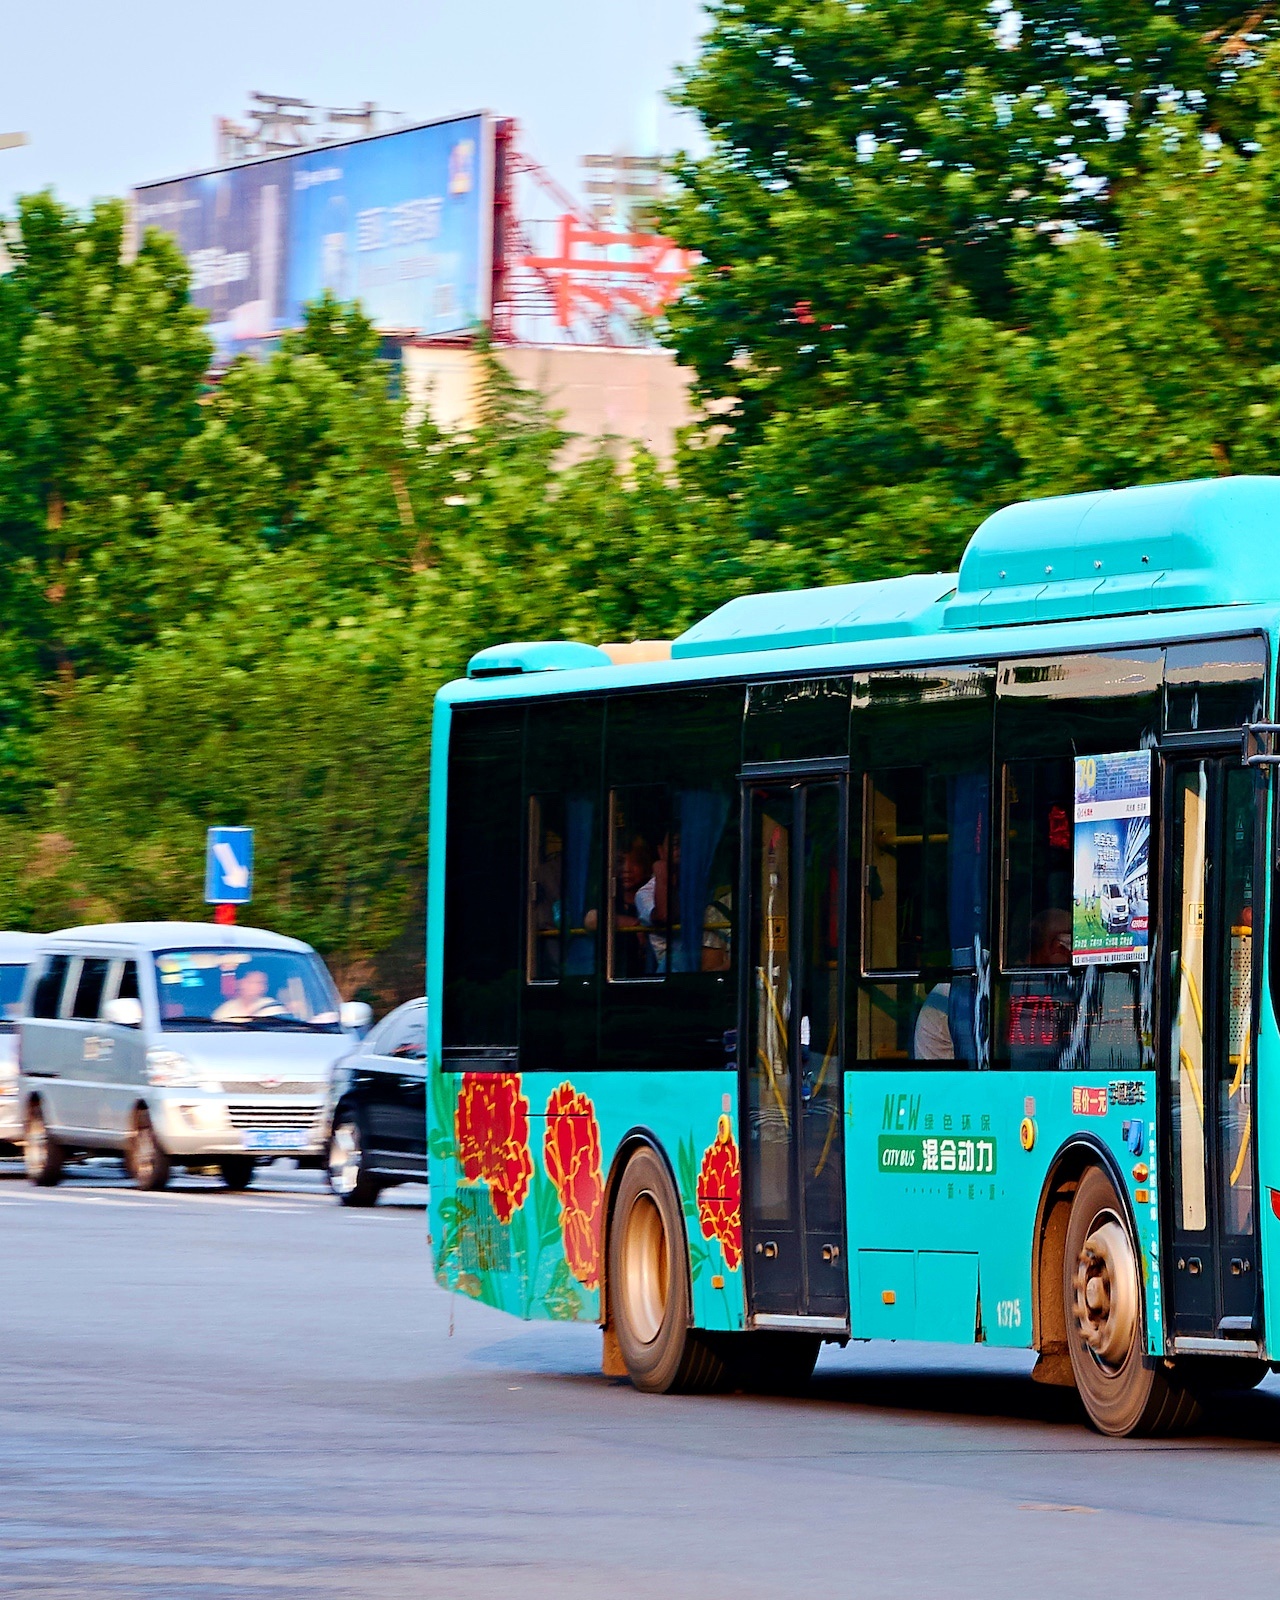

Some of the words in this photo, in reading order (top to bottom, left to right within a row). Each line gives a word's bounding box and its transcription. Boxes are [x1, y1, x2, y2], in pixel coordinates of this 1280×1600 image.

[881, 1093, 922, 1131] NEW
[1073, 1088, 1107, 1113] 票价一元
[924, 1113, 991, 1132] 绿色环保
[882, 1148, 900, 1166] CITY
[899, 1149, 916, 1167] BUS
[922, 1138, 994, 1173] 混合动力
